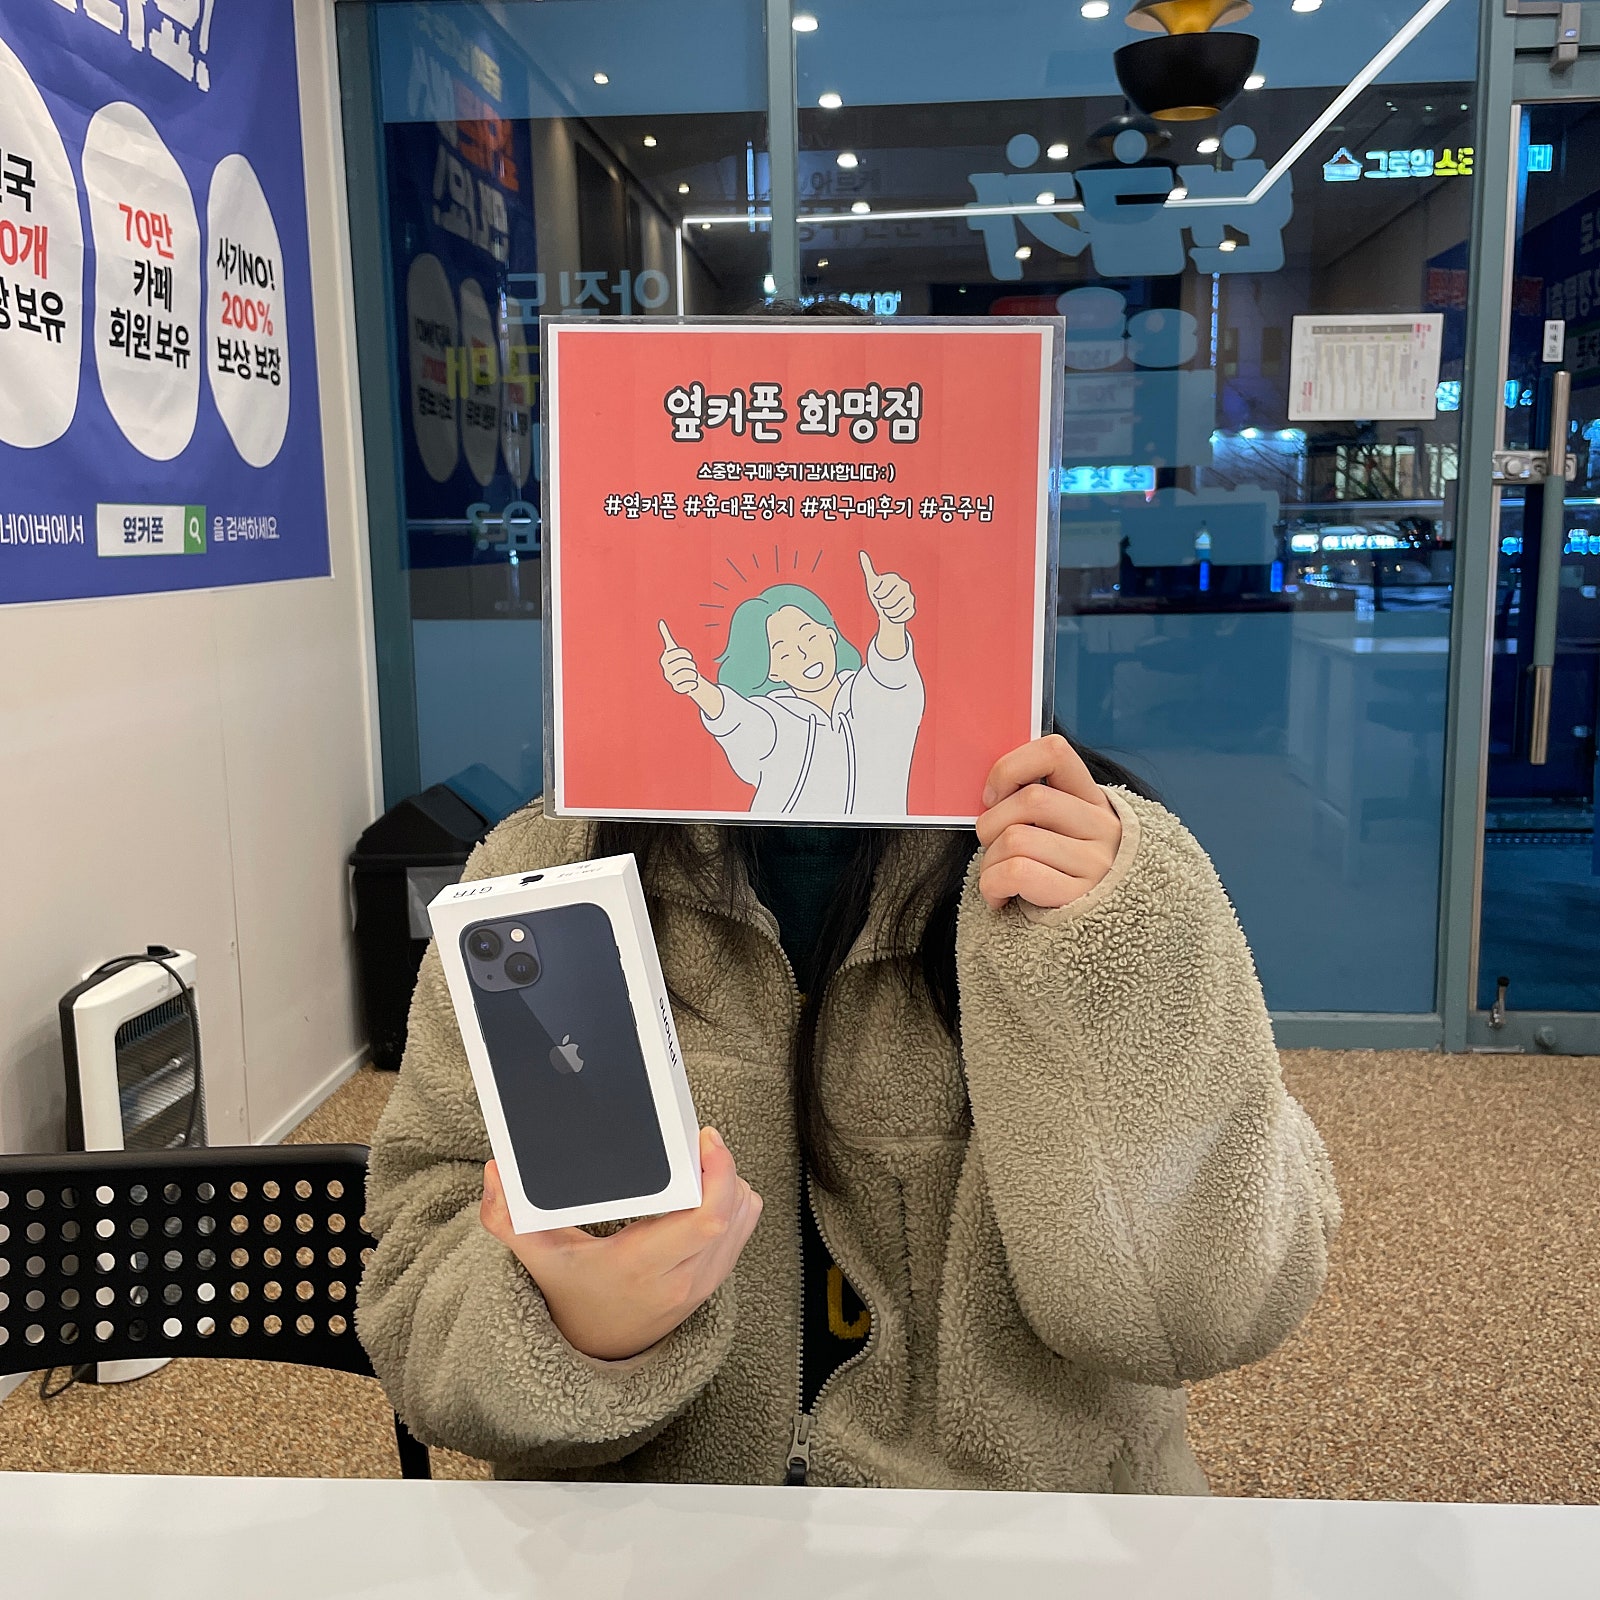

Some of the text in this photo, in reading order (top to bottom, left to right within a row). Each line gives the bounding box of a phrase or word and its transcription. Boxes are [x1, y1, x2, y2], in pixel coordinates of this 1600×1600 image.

[0, 150, 36, 213] 국
[119, 203, 174, 259] 70만
[133, 260, 172, 312] 카페
[217, 237, 276, 291] 사기NO!
[15, 283, 66, 343] 보유
[109, 307, 191, 369] 회원 보유
[221, 291, 273, 336] 200%
[217, 336, 281, 387] 보상 보장
[665, 382, 923, 443] 옆커폰 화명점
[698, 462, 742, 481] 소중한
[744, 463, 772, 481] 구매
[775, 463, 803, 481] 후기
[0, 513, 84, 545] 네이버에서
[123, 516, 164, 544] 옆커폰
[213, 515, 225, 542] 을
[604, 492, 994, 522] #옆커폰 #휴대폰성지 #찐구매후기 #공주님
